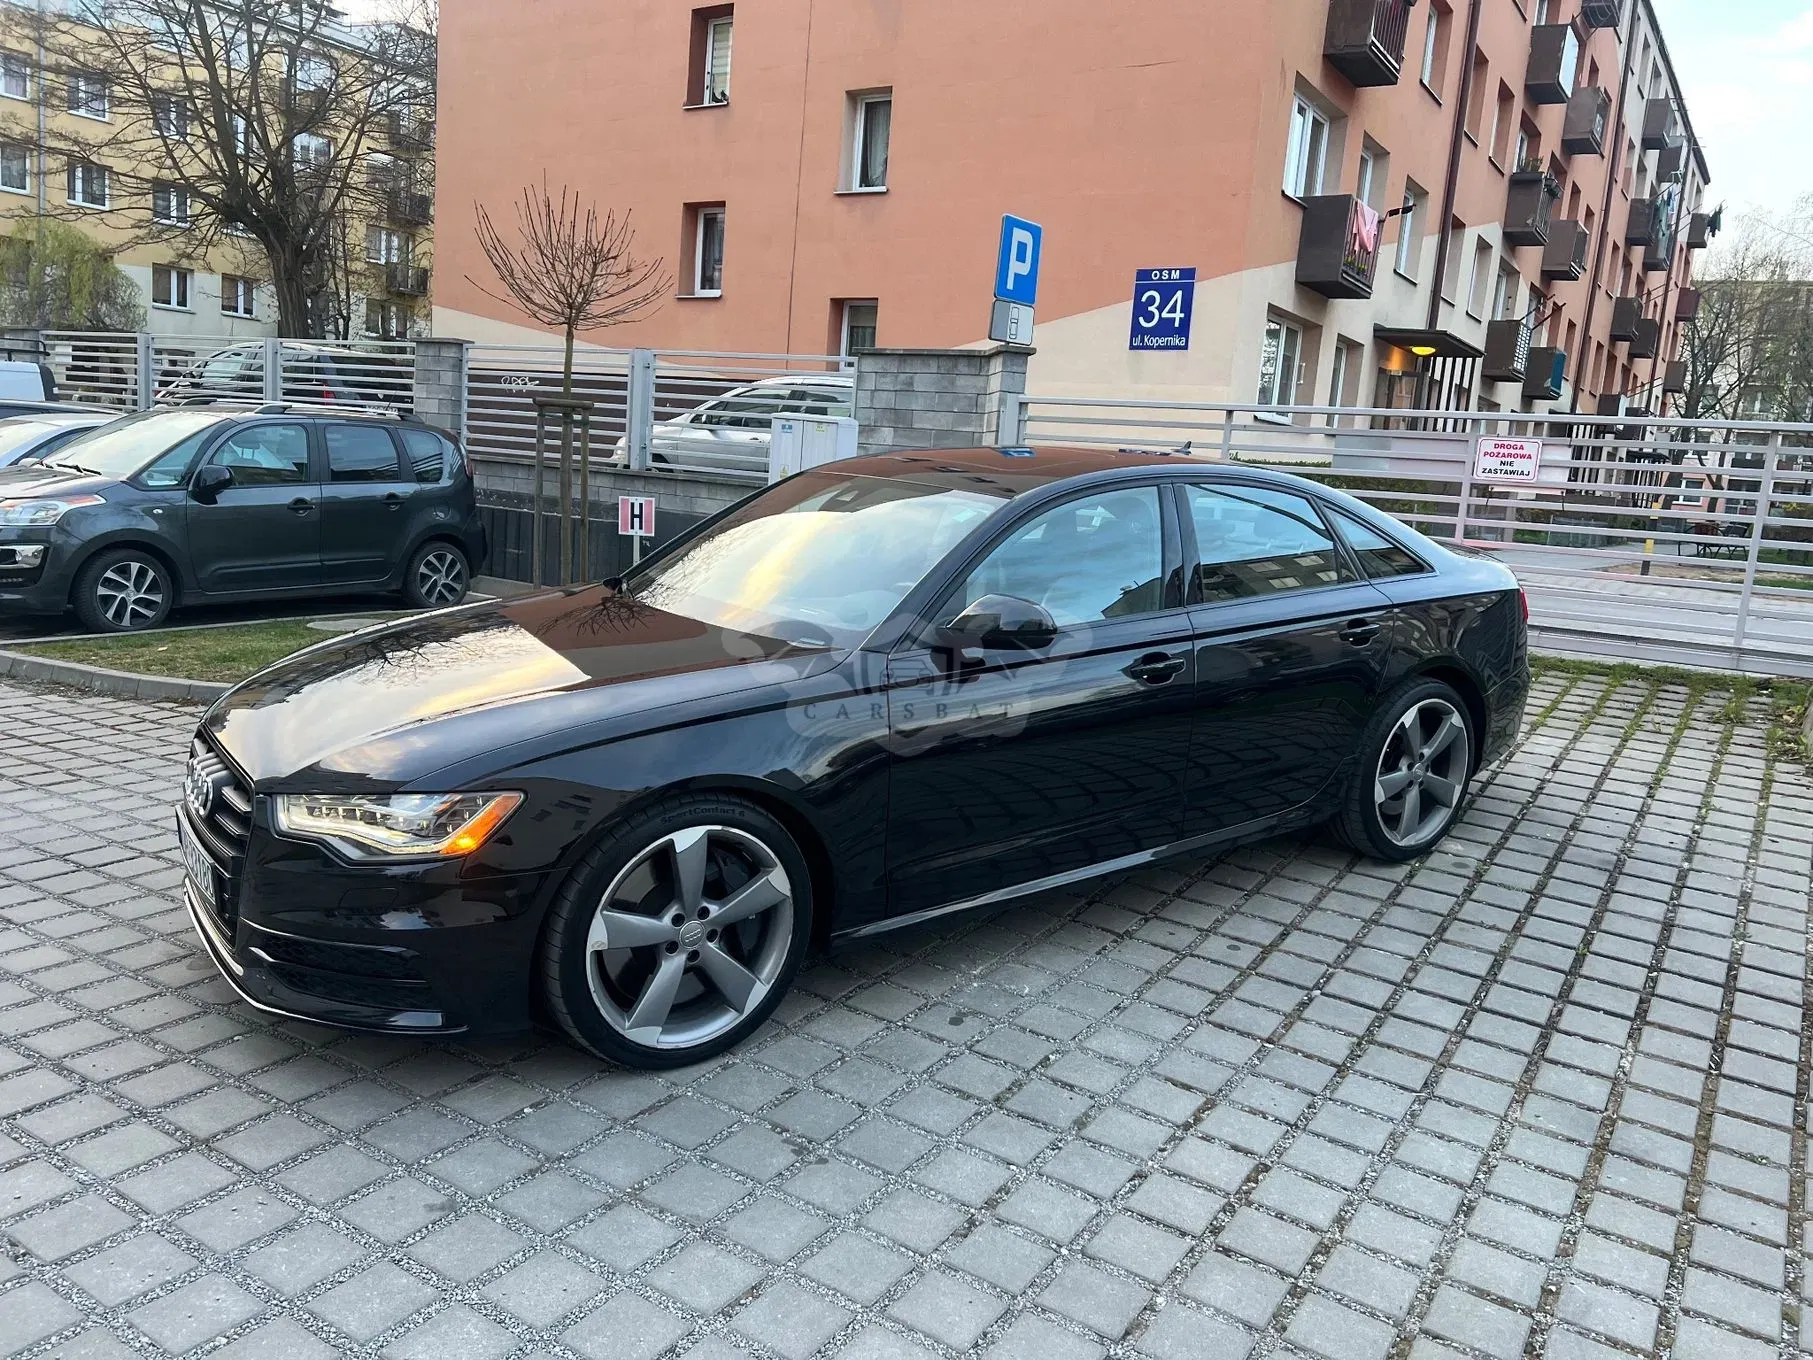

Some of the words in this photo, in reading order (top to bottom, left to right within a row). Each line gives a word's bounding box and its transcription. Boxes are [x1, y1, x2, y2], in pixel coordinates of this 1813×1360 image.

[1007, 227, 1033, 290] P
[1151, 269, 1180, 280] OSM
[1138, 289, 1185, 328] 34
[1132, 333, 1143, 346] ul.
[1143, 333, 1186, 349] Kopernika
[1481, 467, 1531, 476] ZASTAWIAJ
[630, 502, 643, 530] H
